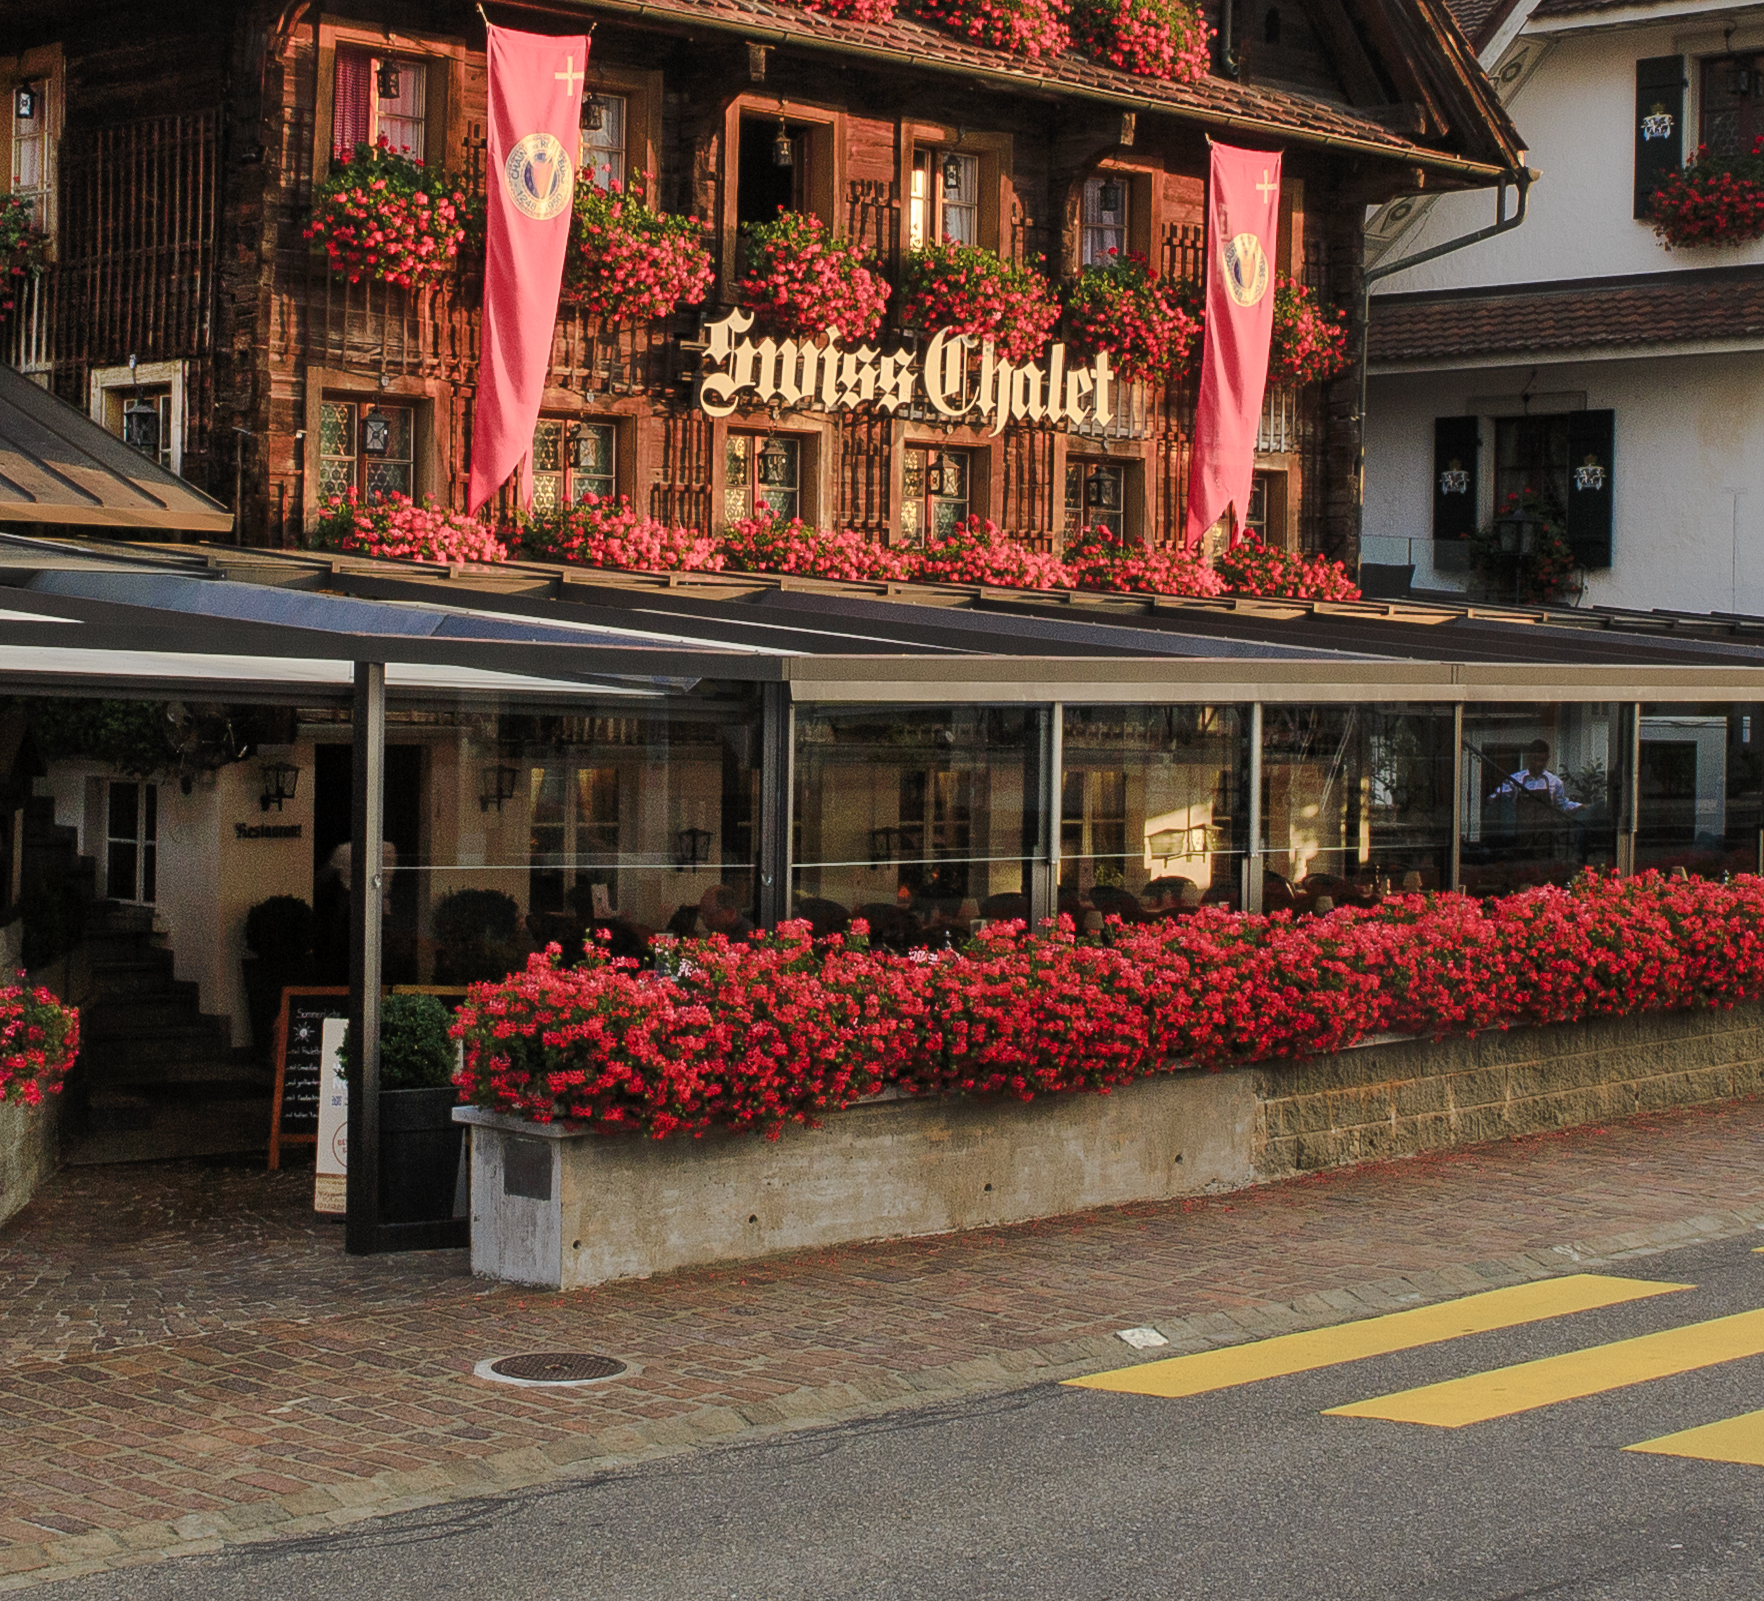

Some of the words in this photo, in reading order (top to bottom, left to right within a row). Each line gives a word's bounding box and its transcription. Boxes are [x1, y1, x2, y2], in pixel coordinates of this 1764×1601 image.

[511, 149, 527, 180] CHAIN
[701, 307, 918, 417] Swiss
[924, 324, 1115, 438] Chalet
[234, 821, 303, 839] Restaurant
